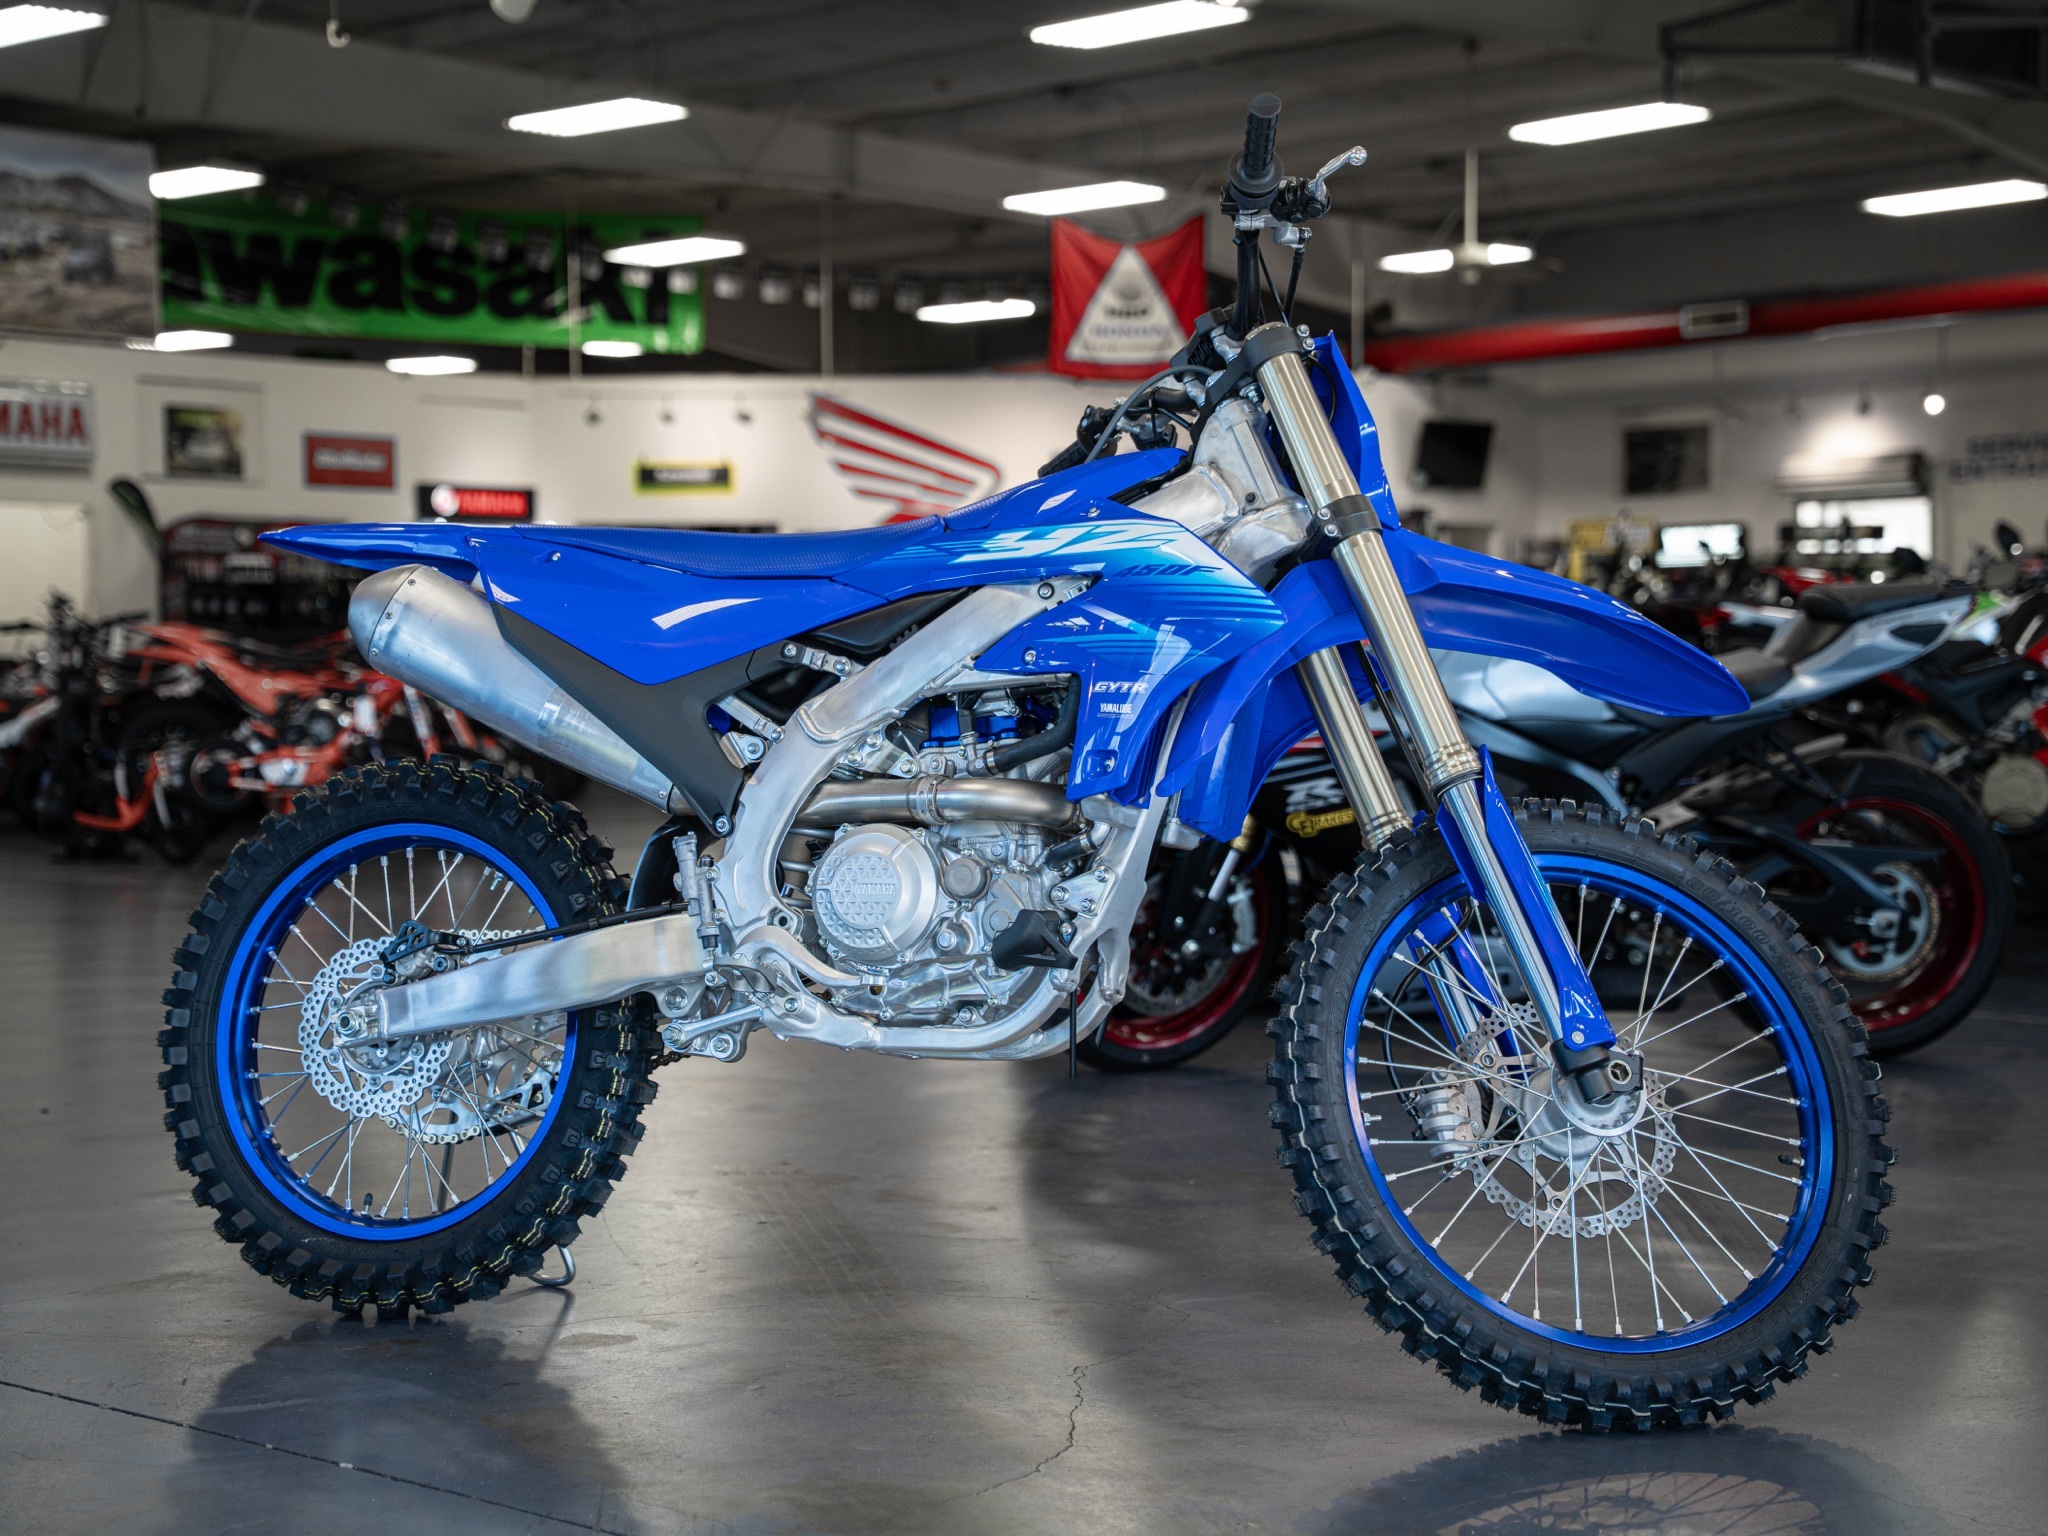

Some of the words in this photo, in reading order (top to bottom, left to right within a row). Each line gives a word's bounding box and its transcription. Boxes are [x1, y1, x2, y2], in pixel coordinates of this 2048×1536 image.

[949, 520, 1178, 564] YZ
[1111, 564, 1223, 578] 450F
[1092, 681, 1148, 693] GYTR
[1100, 702, 1133, 714] YAMALUBE
[857, 883, 896, 895] YAMAHA
